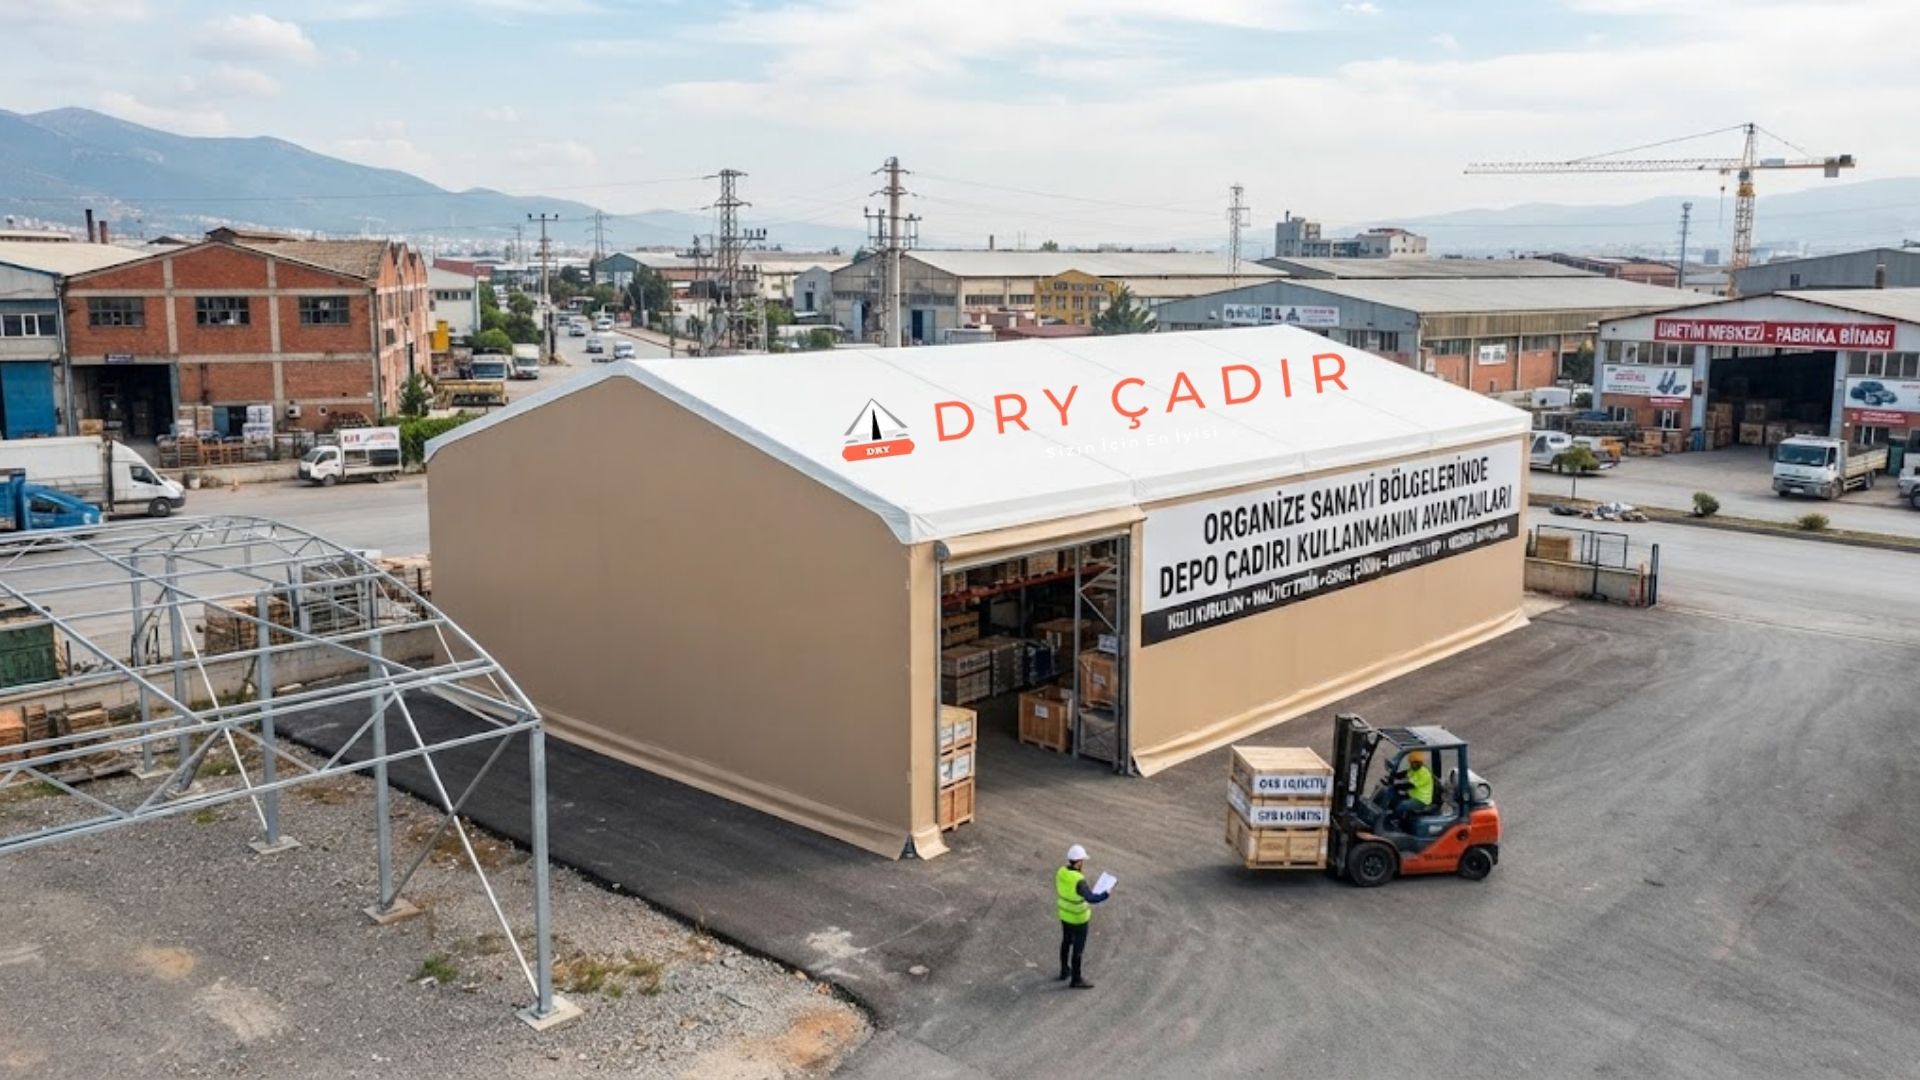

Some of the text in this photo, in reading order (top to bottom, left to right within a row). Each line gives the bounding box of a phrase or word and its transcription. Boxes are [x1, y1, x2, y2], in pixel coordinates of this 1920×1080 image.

[1204, 490, 1306, 545] ORGANİZE
[1311, 471, 1375, 521] SANAYİ
[1160, 554, 1218, 598] DEPO
[1225, 536, 1291, 589] ÇADIRI
[1297, 505, 1418, 563] KULLANMANIN
